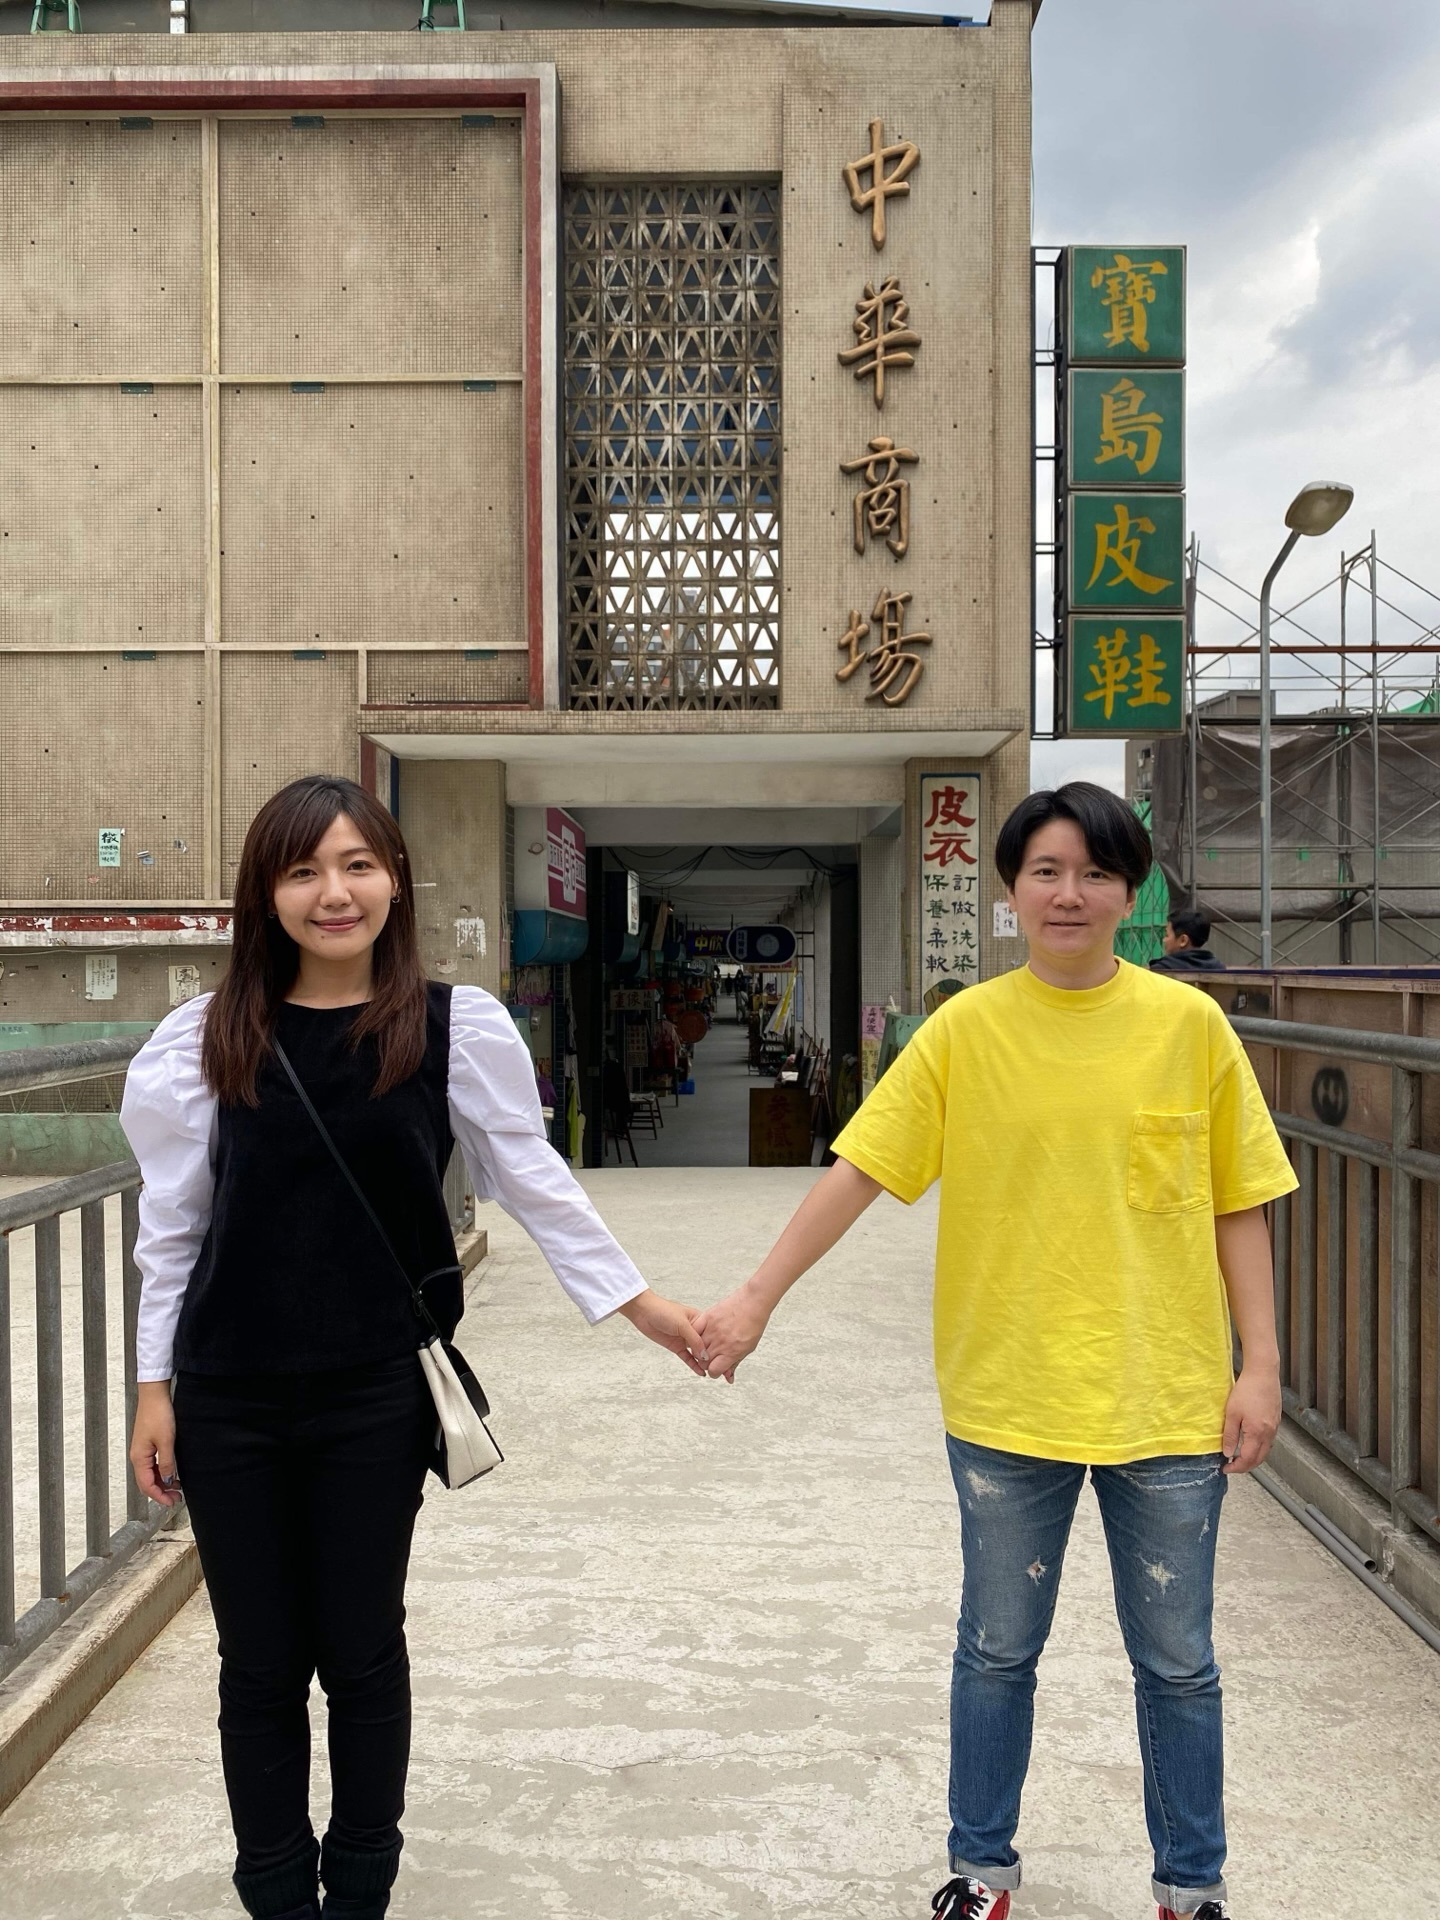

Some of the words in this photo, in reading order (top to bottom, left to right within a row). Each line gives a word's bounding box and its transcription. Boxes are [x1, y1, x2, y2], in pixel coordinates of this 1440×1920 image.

[836, 116, 933, 707] 中華商場
[1084, 253, 1176, 720] 寶島皮鞋
[923, 785, 978, 867] 皮衣
